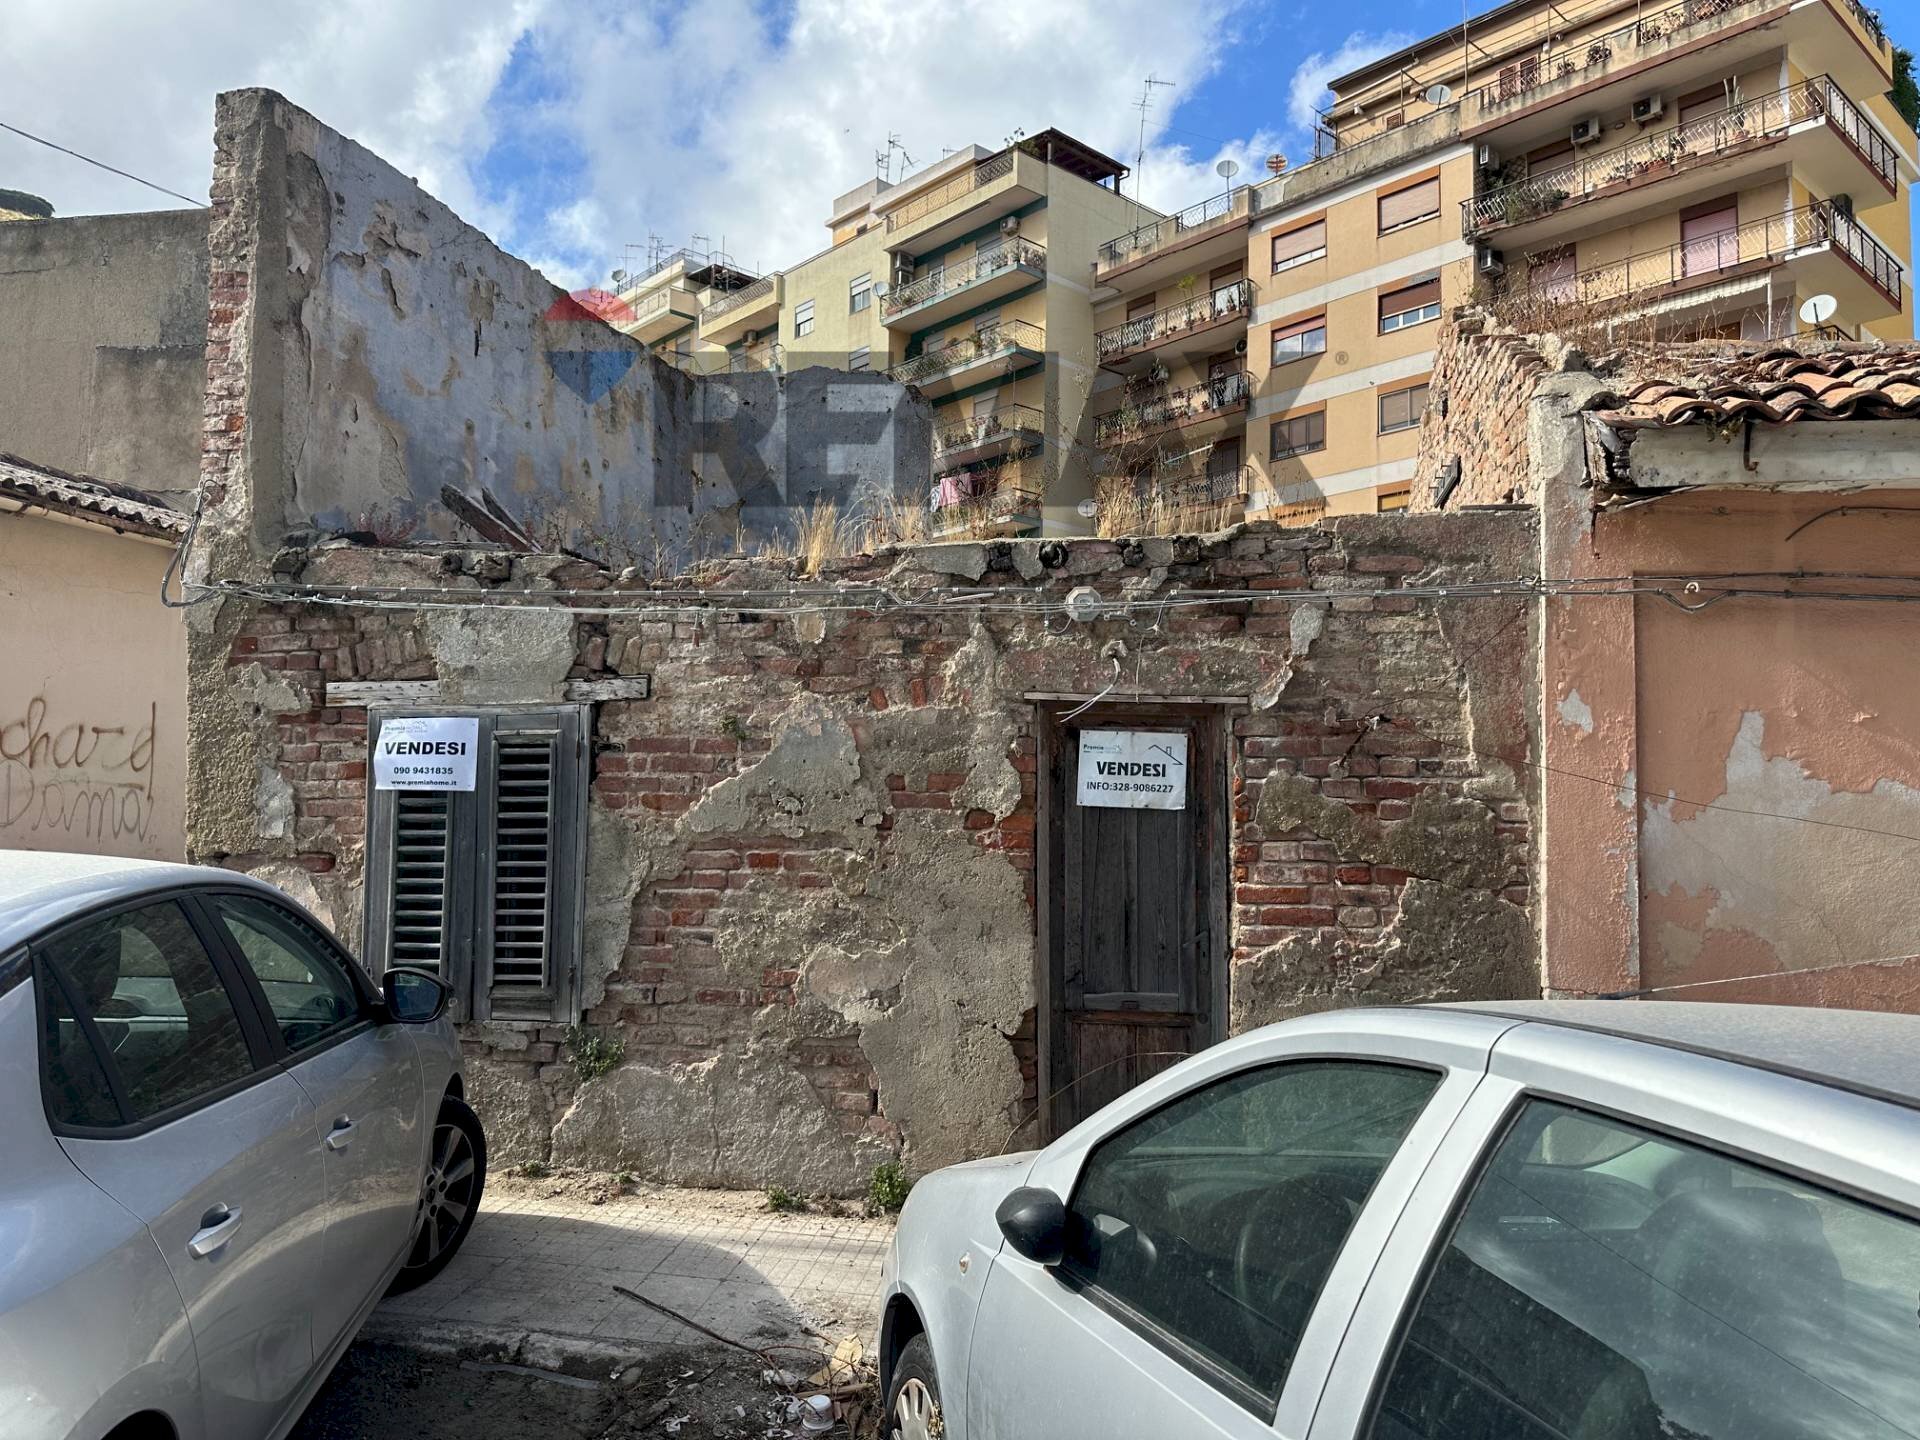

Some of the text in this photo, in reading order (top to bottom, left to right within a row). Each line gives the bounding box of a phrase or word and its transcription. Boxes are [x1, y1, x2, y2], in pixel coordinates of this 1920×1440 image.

[385, 741, 467, 756] VENDESI
[393, 766, 454, 775] 090 9431835
[1096, 761, 1167, 778] VENDESI
[1086, 781, 1174, 794] INFO:328-9086227
